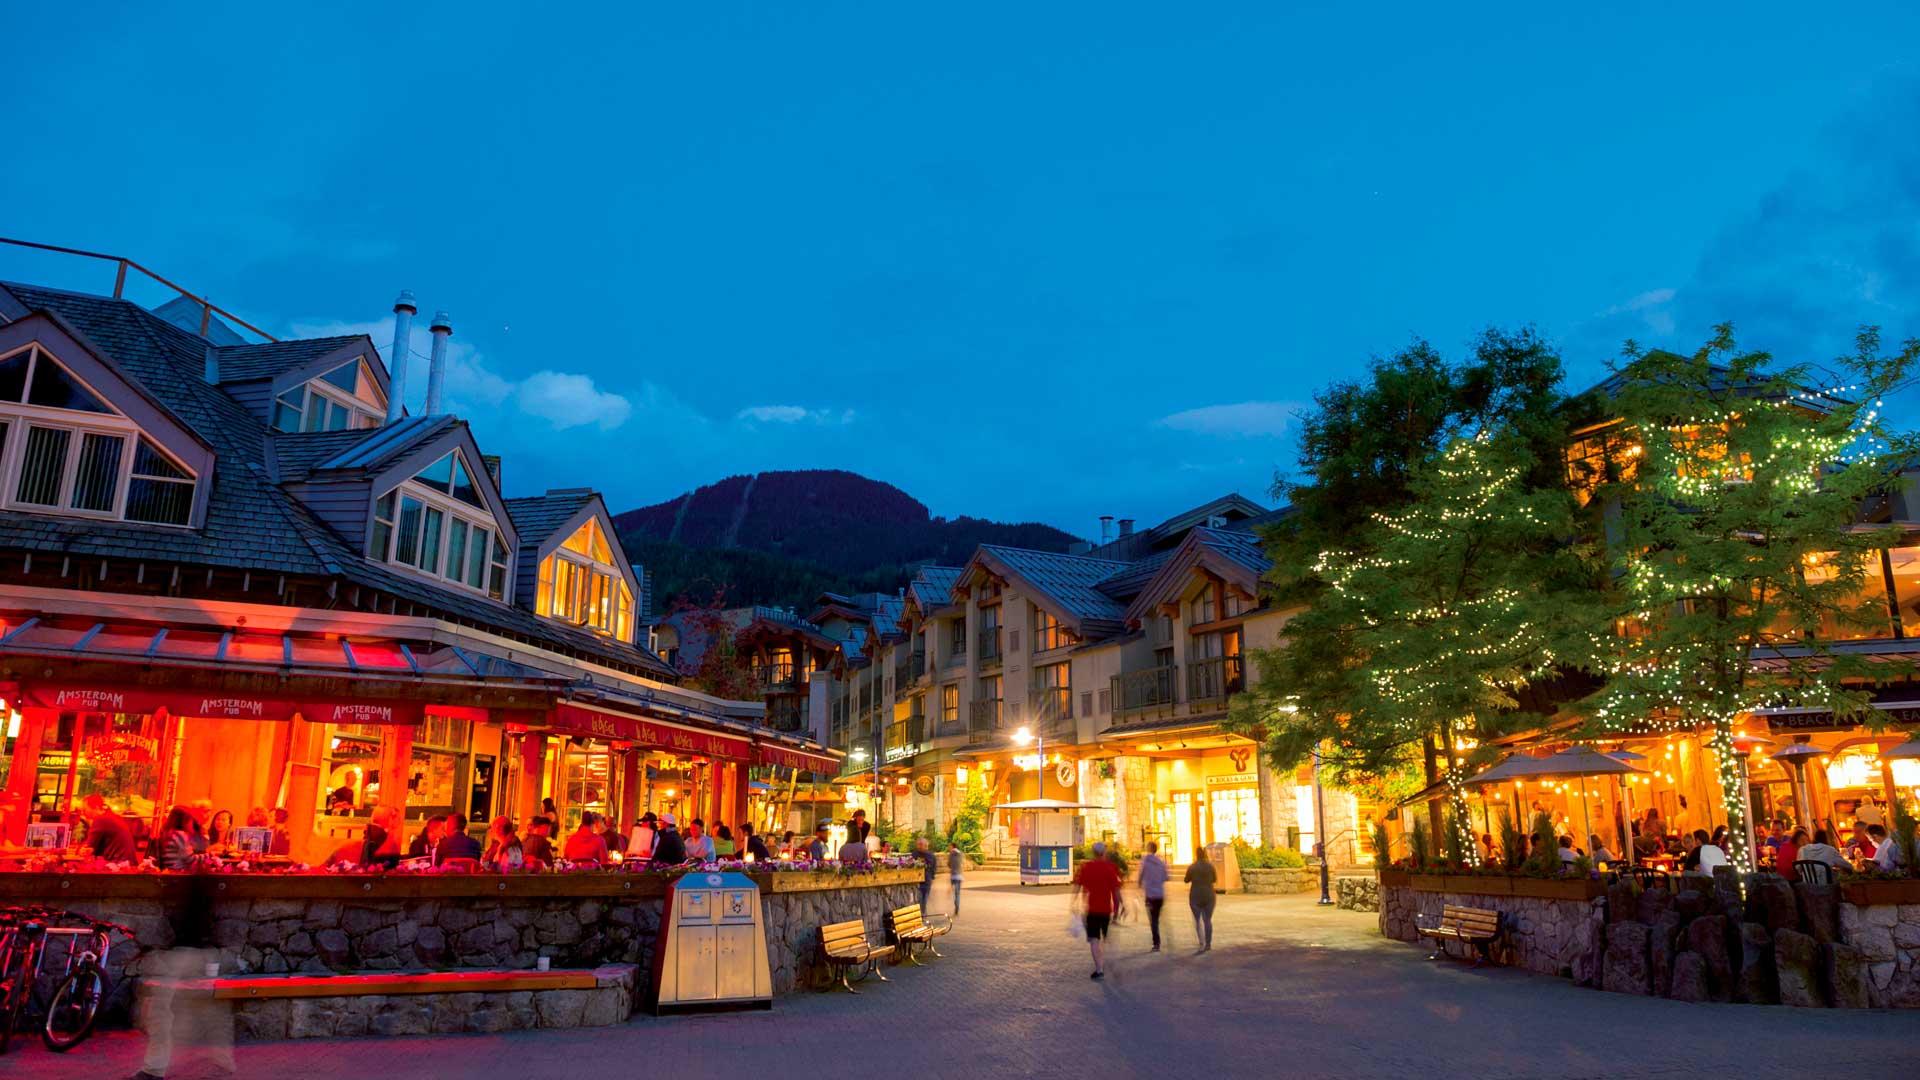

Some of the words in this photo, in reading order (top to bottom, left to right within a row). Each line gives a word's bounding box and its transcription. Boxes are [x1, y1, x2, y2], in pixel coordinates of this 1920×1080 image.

[56, 690, 124, 709] AMSTERDAM
[82, 699, 98, 707] PUB
[200, 698, 263, 716] AMSTERDAM
[224, 707, 240, 715] PUB
[333, 705, 392, 721] AMSTERDAM
[355, 713, 369, 721] PUB
[1788, 710, 1846, 726] BEACO
